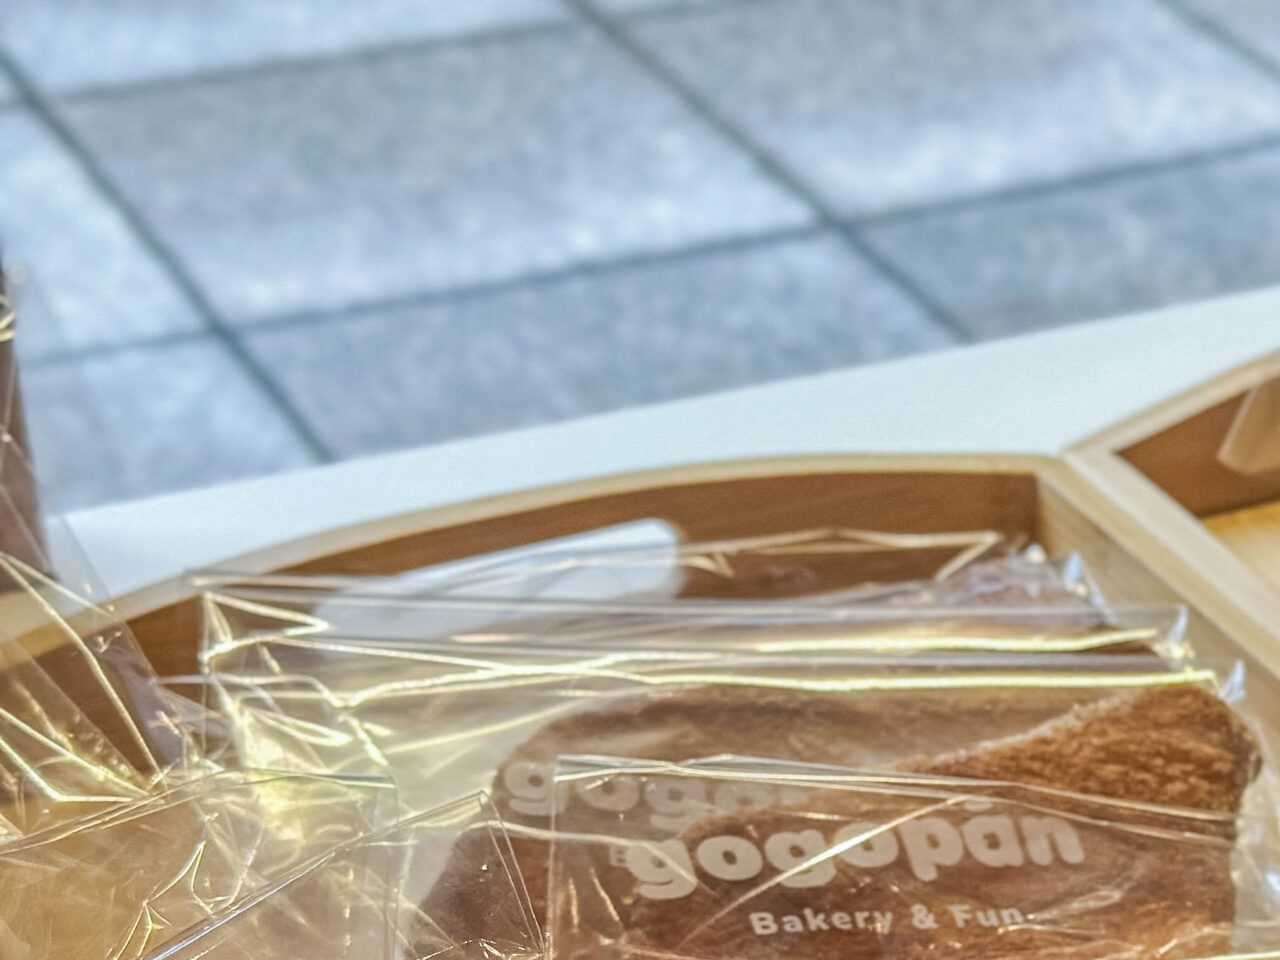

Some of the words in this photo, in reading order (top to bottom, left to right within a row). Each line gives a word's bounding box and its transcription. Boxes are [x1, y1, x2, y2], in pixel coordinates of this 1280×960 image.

[750, 907, 892, 935] Bakery
[911, 904, 938, 929] &
[948, 905, 1024, 928] Fun
